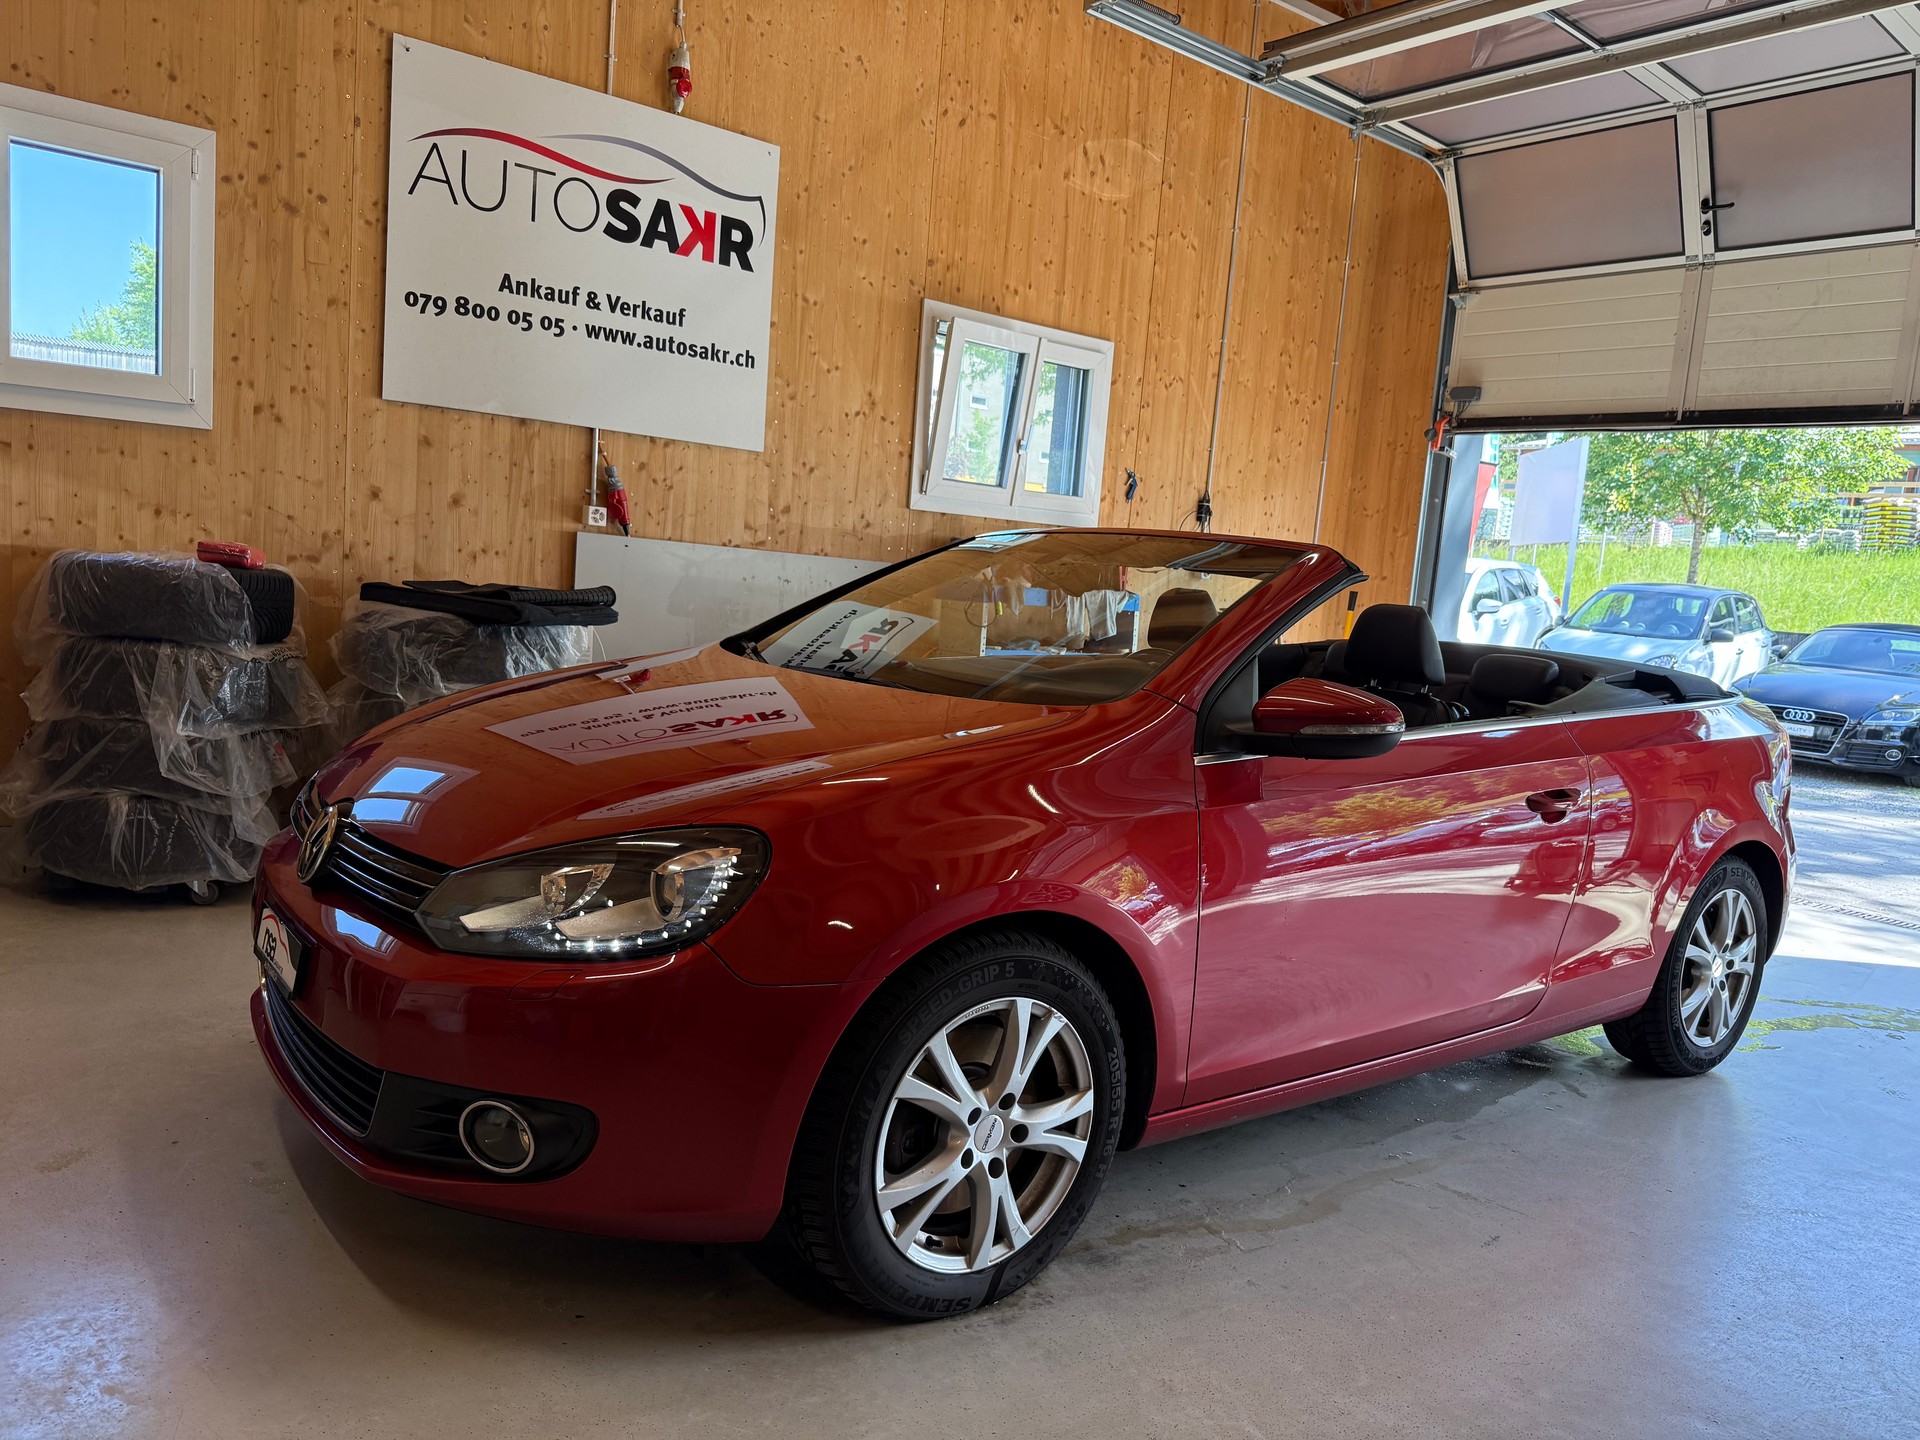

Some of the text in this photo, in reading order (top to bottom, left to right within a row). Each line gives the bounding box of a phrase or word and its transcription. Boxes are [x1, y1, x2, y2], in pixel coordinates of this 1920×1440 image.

[404, 290, 447, 317] 079
[454, 296, 500, 323] 800
[507, 309, 533, 333] 05
[540, 316, 565, 338] 05
[585, 321, 756, 370] www.autosakr.ch
[498, 273, 687, 328] Ankauf & Verkauf
[897, 964, 1000, 1045] SPEED-GRIP
[1004, 960, 1017, 979] 5
[1106, 1046, 1121, 1112] 205/55
[1102, 1135, 1115, 1157] 16
[1107, 1115, 1119, 1130] R
